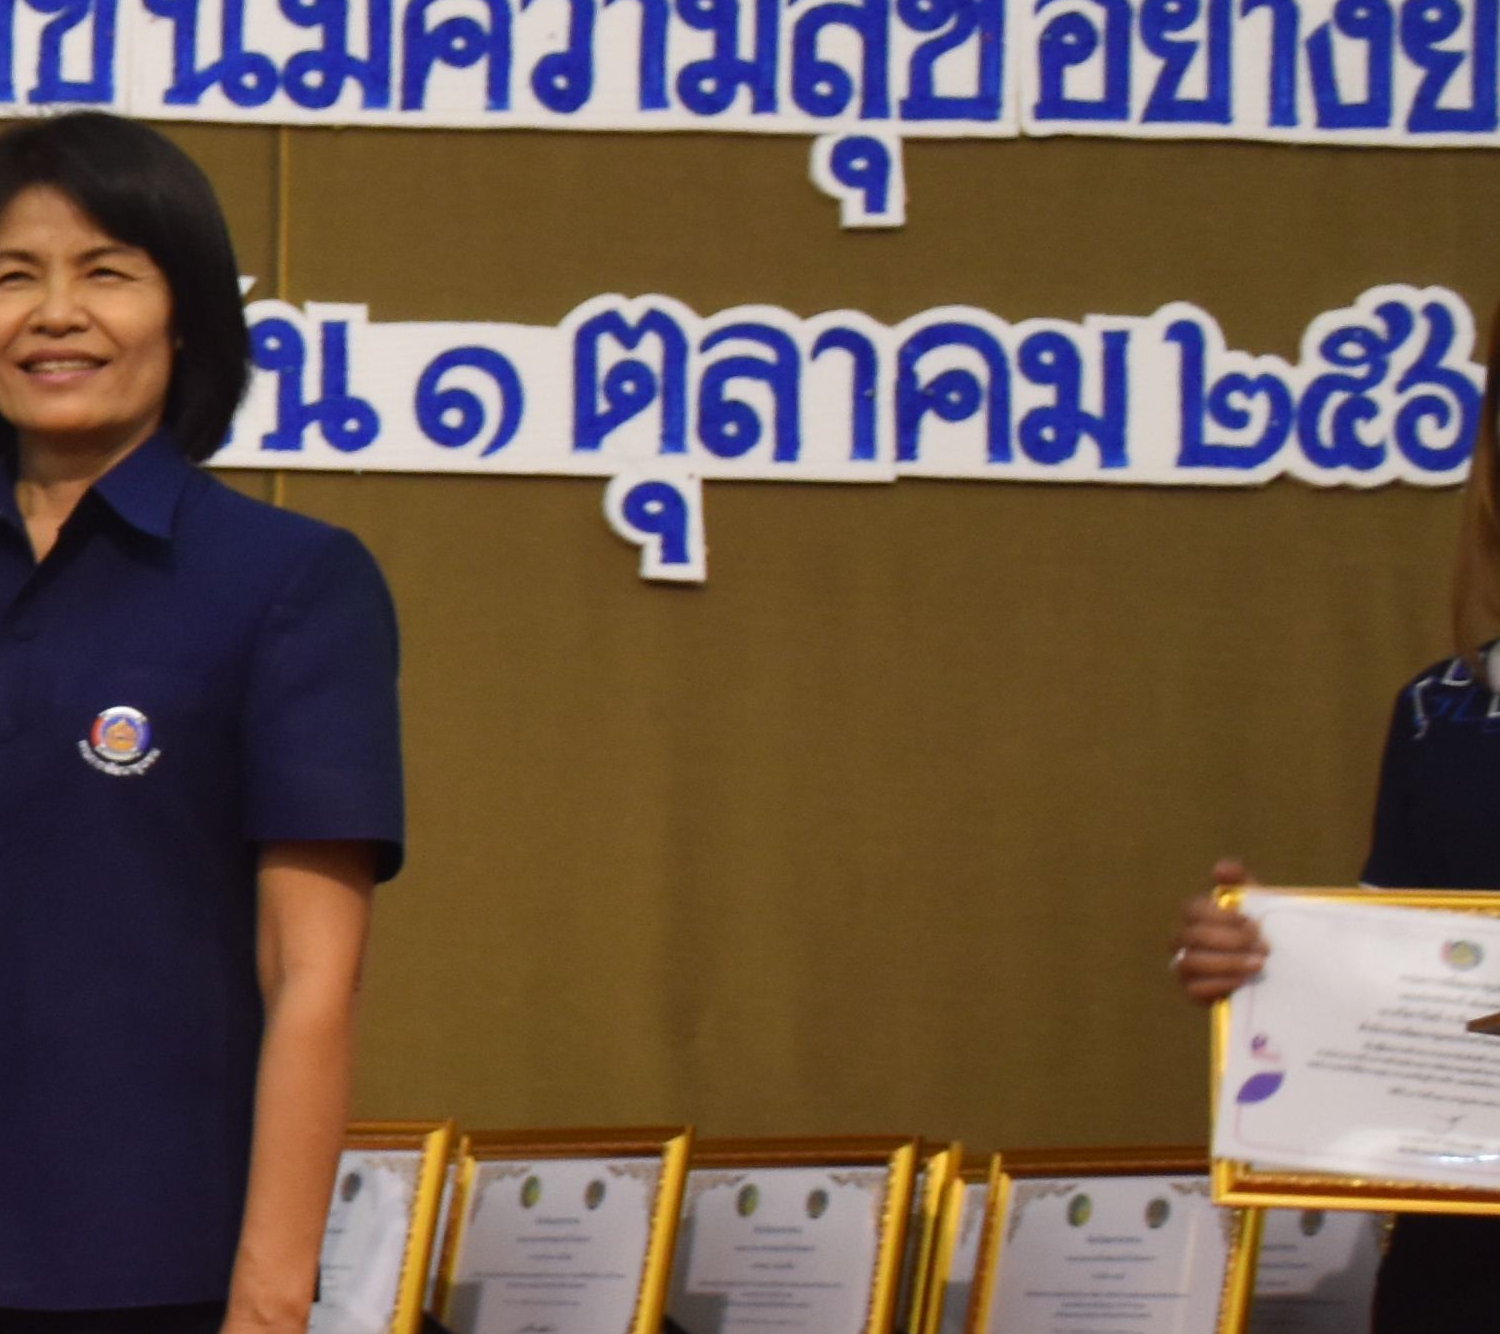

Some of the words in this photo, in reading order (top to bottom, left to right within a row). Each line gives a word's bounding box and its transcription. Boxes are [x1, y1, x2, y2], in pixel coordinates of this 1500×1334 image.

[574, 308, 1129, 564] ตุลาคม
[1164, 301, 1484, 472] ๒๕๖
